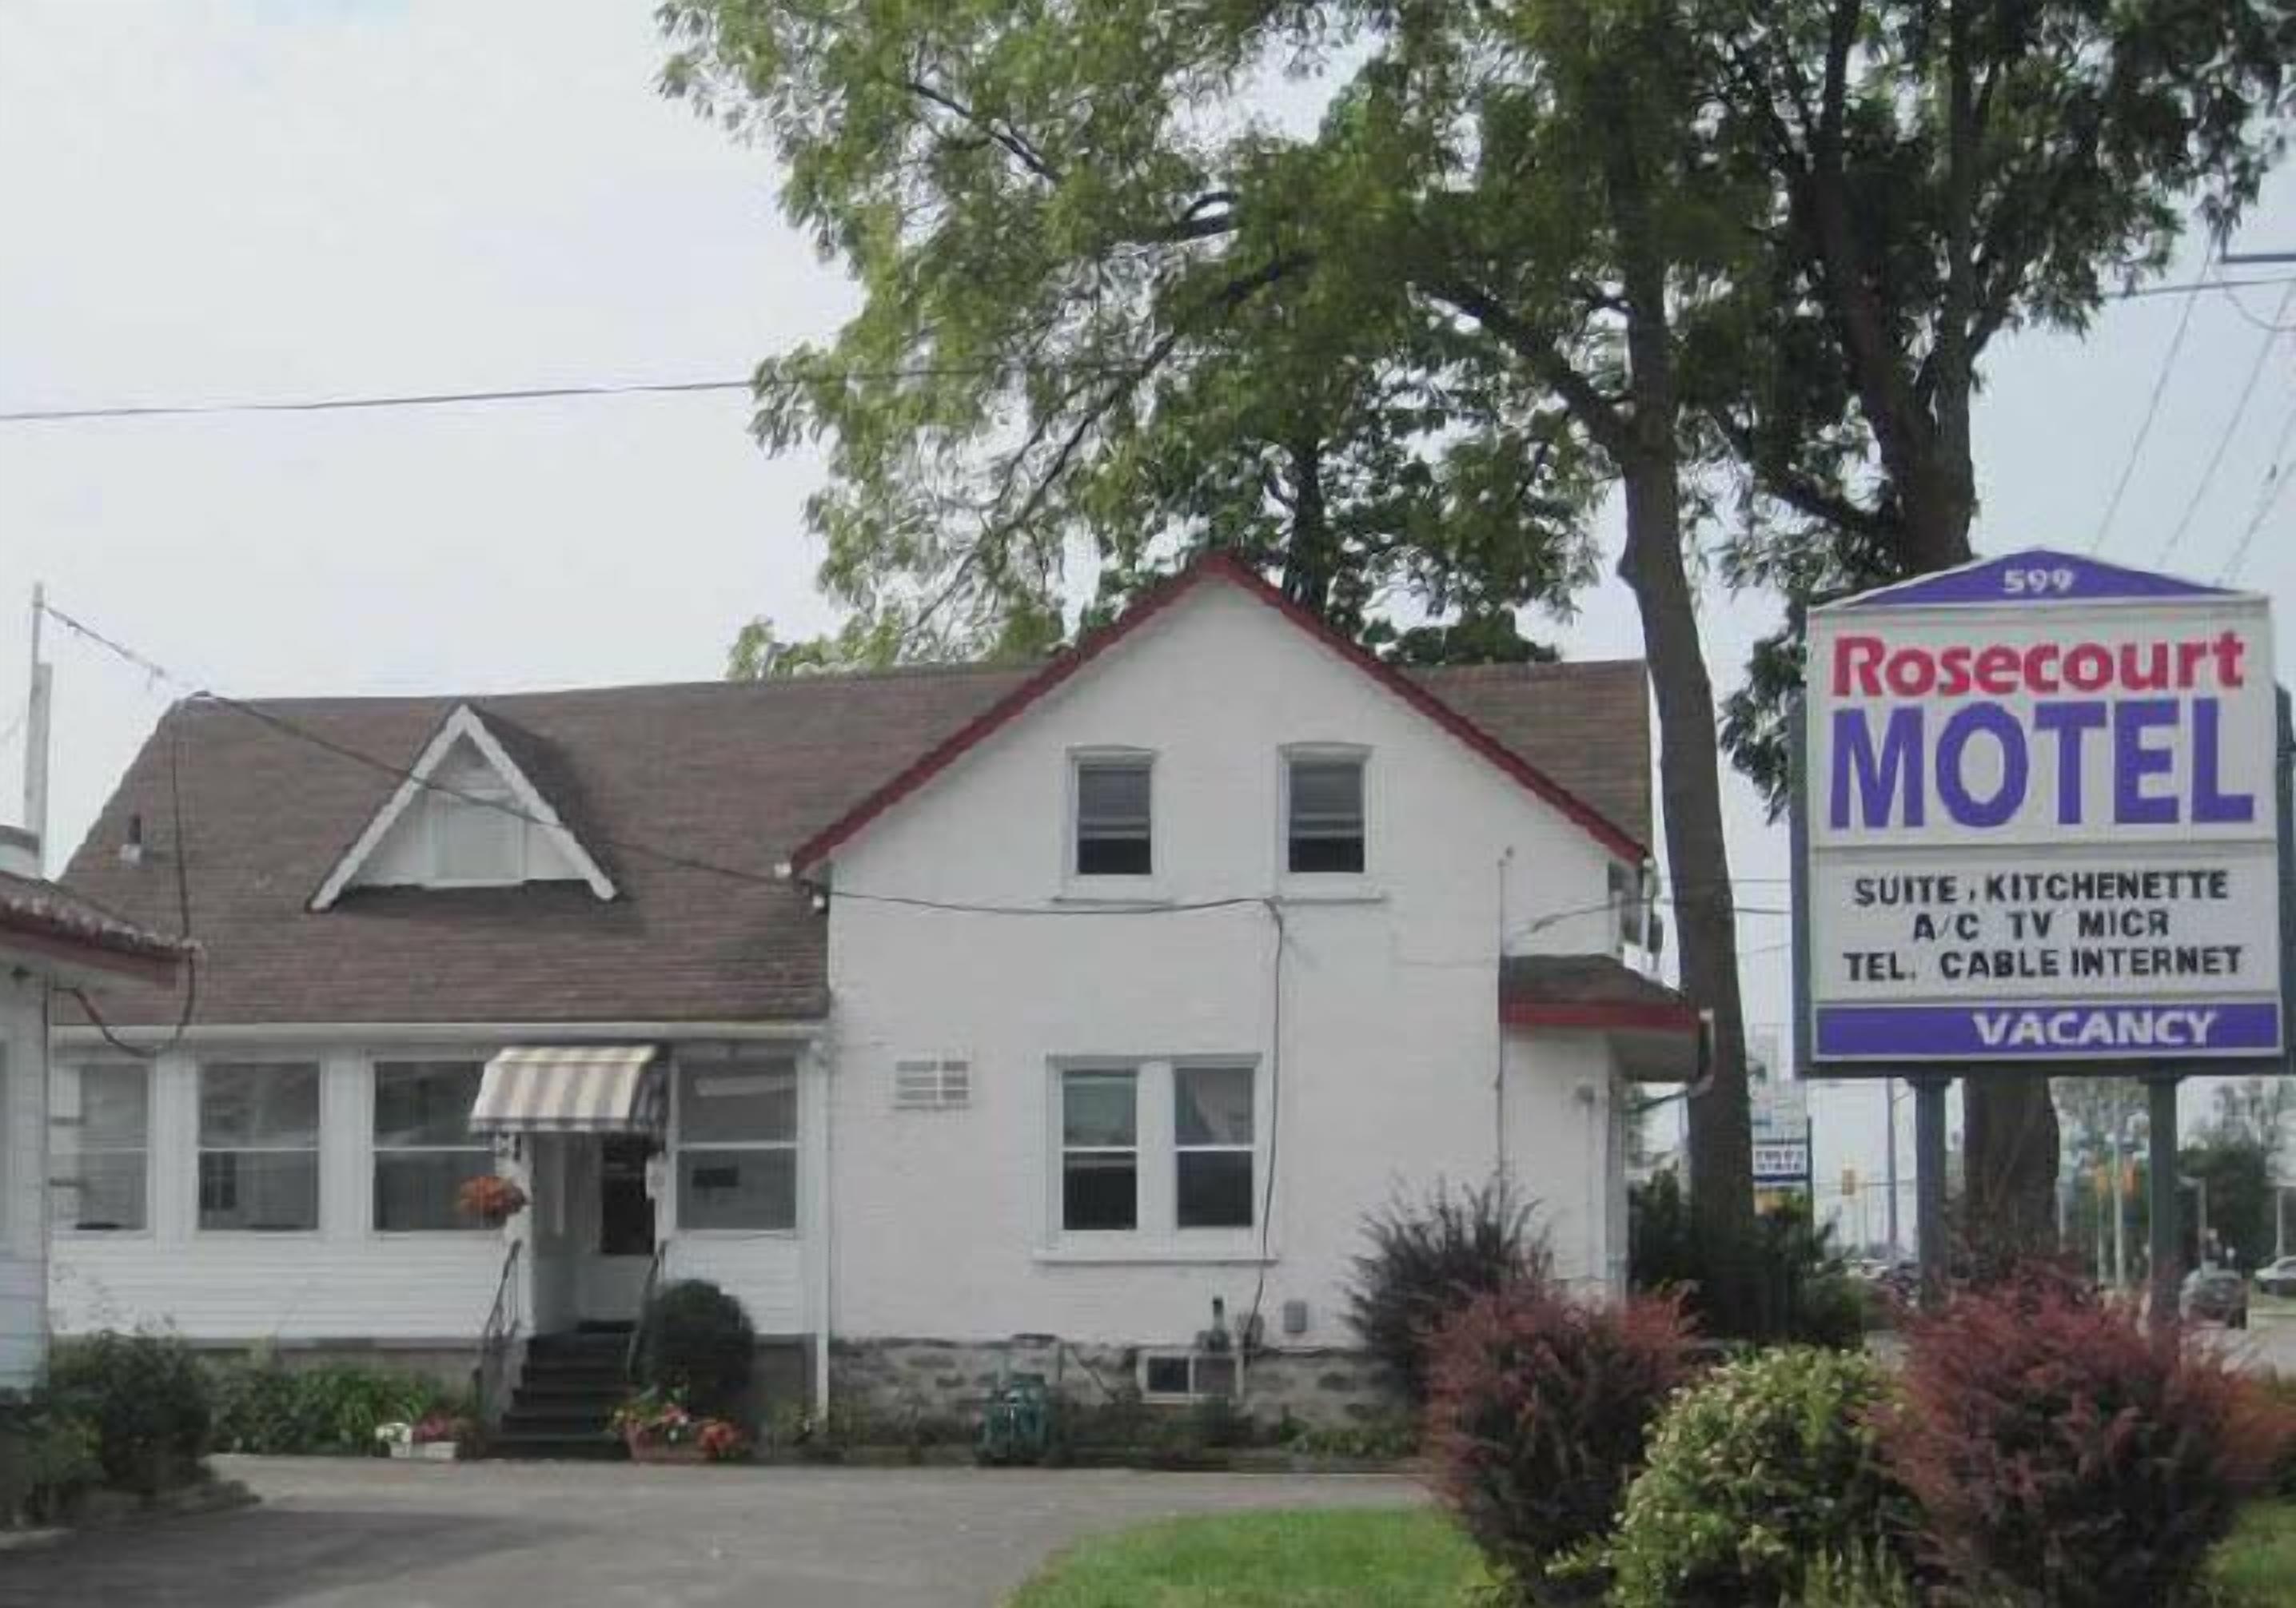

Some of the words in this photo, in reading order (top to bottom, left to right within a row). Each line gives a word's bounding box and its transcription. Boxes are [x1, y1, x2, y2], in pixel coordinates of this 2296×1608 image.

[2003, 568, 2074, 594] 599
[1832, 630, 2245, 697] Rosecourt
[1829, 698, 2254, 830] MOTEL
[1985, 869, 2229, 902] KITCHENETTE
[1913, 912, 1979, 942] A/C
[2007, 909, 2052, 940] TV
[2078, 909, 2169, 938] MICR
[1940, 949, 2060, 979] CABLE
[2071, 945, 2242, 977] INTERNET
[1973, 1010, 2219, 1046] VACANCY
